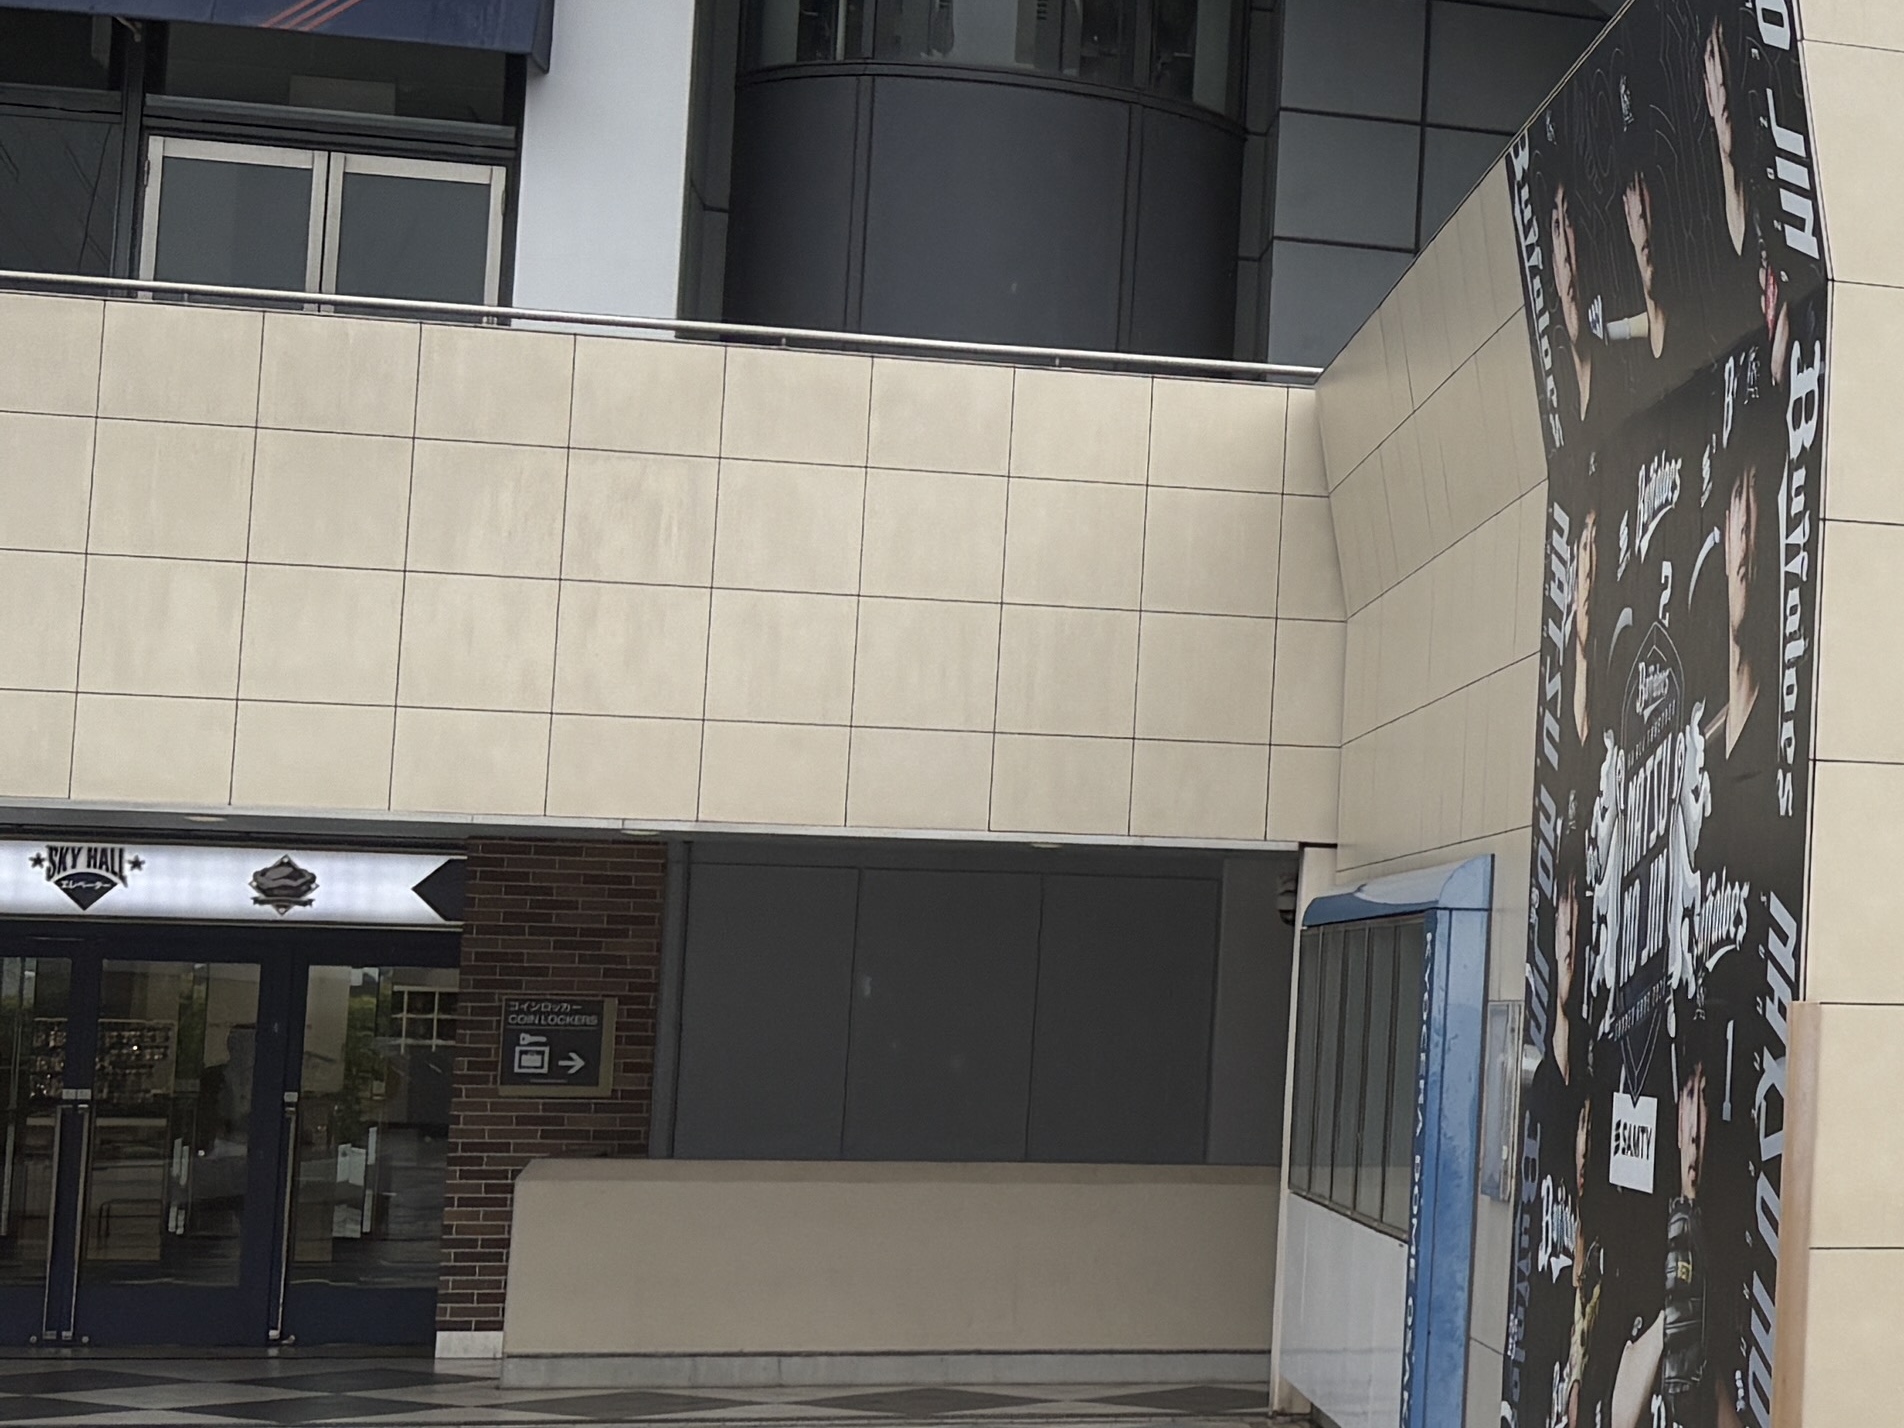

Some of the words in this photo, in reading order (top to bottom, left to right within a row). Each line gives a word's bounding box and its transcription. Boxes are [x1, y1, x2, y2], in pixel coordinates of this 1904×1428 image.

[46, 844, 83, 882] SKY
[86, 845, 128, 888] HALL
[508, 1001, 583, 1012] コインロッカー
[508, 1014, 539, 1025] COIN
[541, 1014, 598, 1026] LOCKERS
[1620, 1119, 1654, 1162] SAMTY
